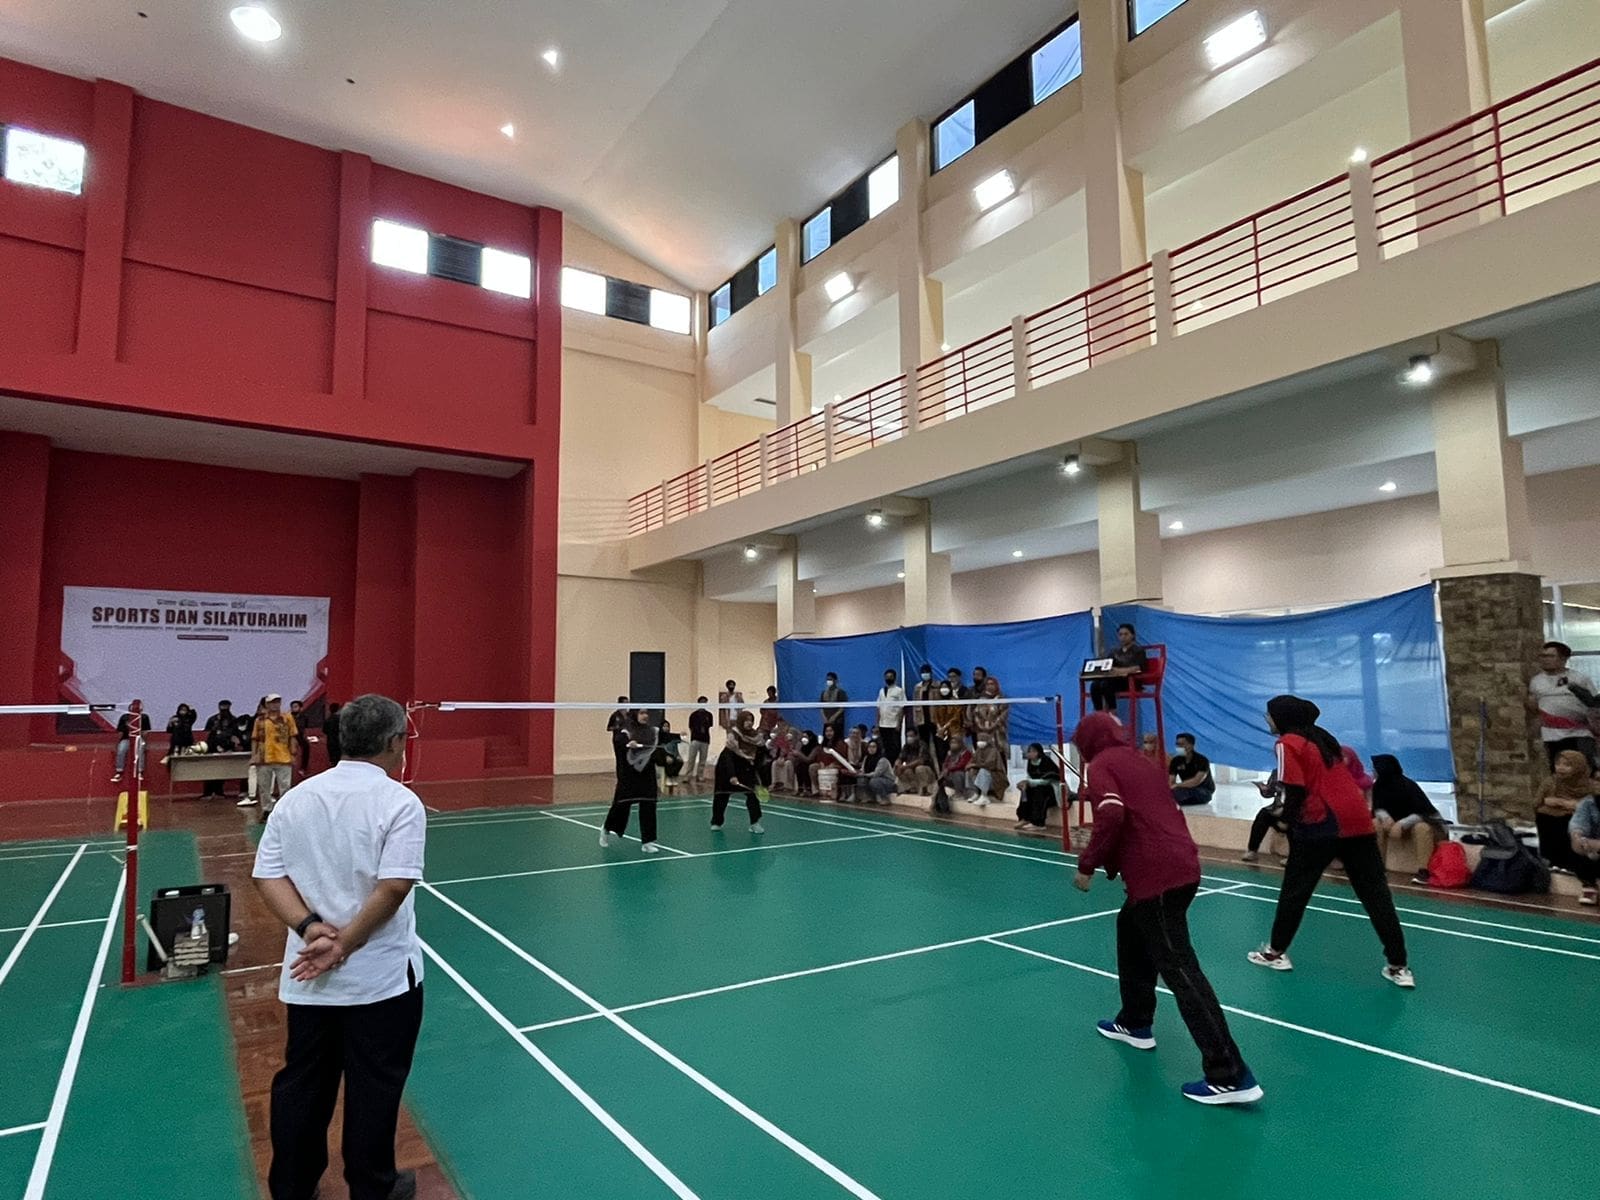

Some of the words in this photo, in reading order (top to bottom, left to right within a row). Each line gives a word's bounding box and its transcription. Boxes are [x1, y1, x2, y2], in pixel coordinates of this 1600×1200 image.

[92, 606, 160, 624] SPORTS
[165, 608, 198, 625] DAN
[203, 610, 307, 628] SILATURAHIM
